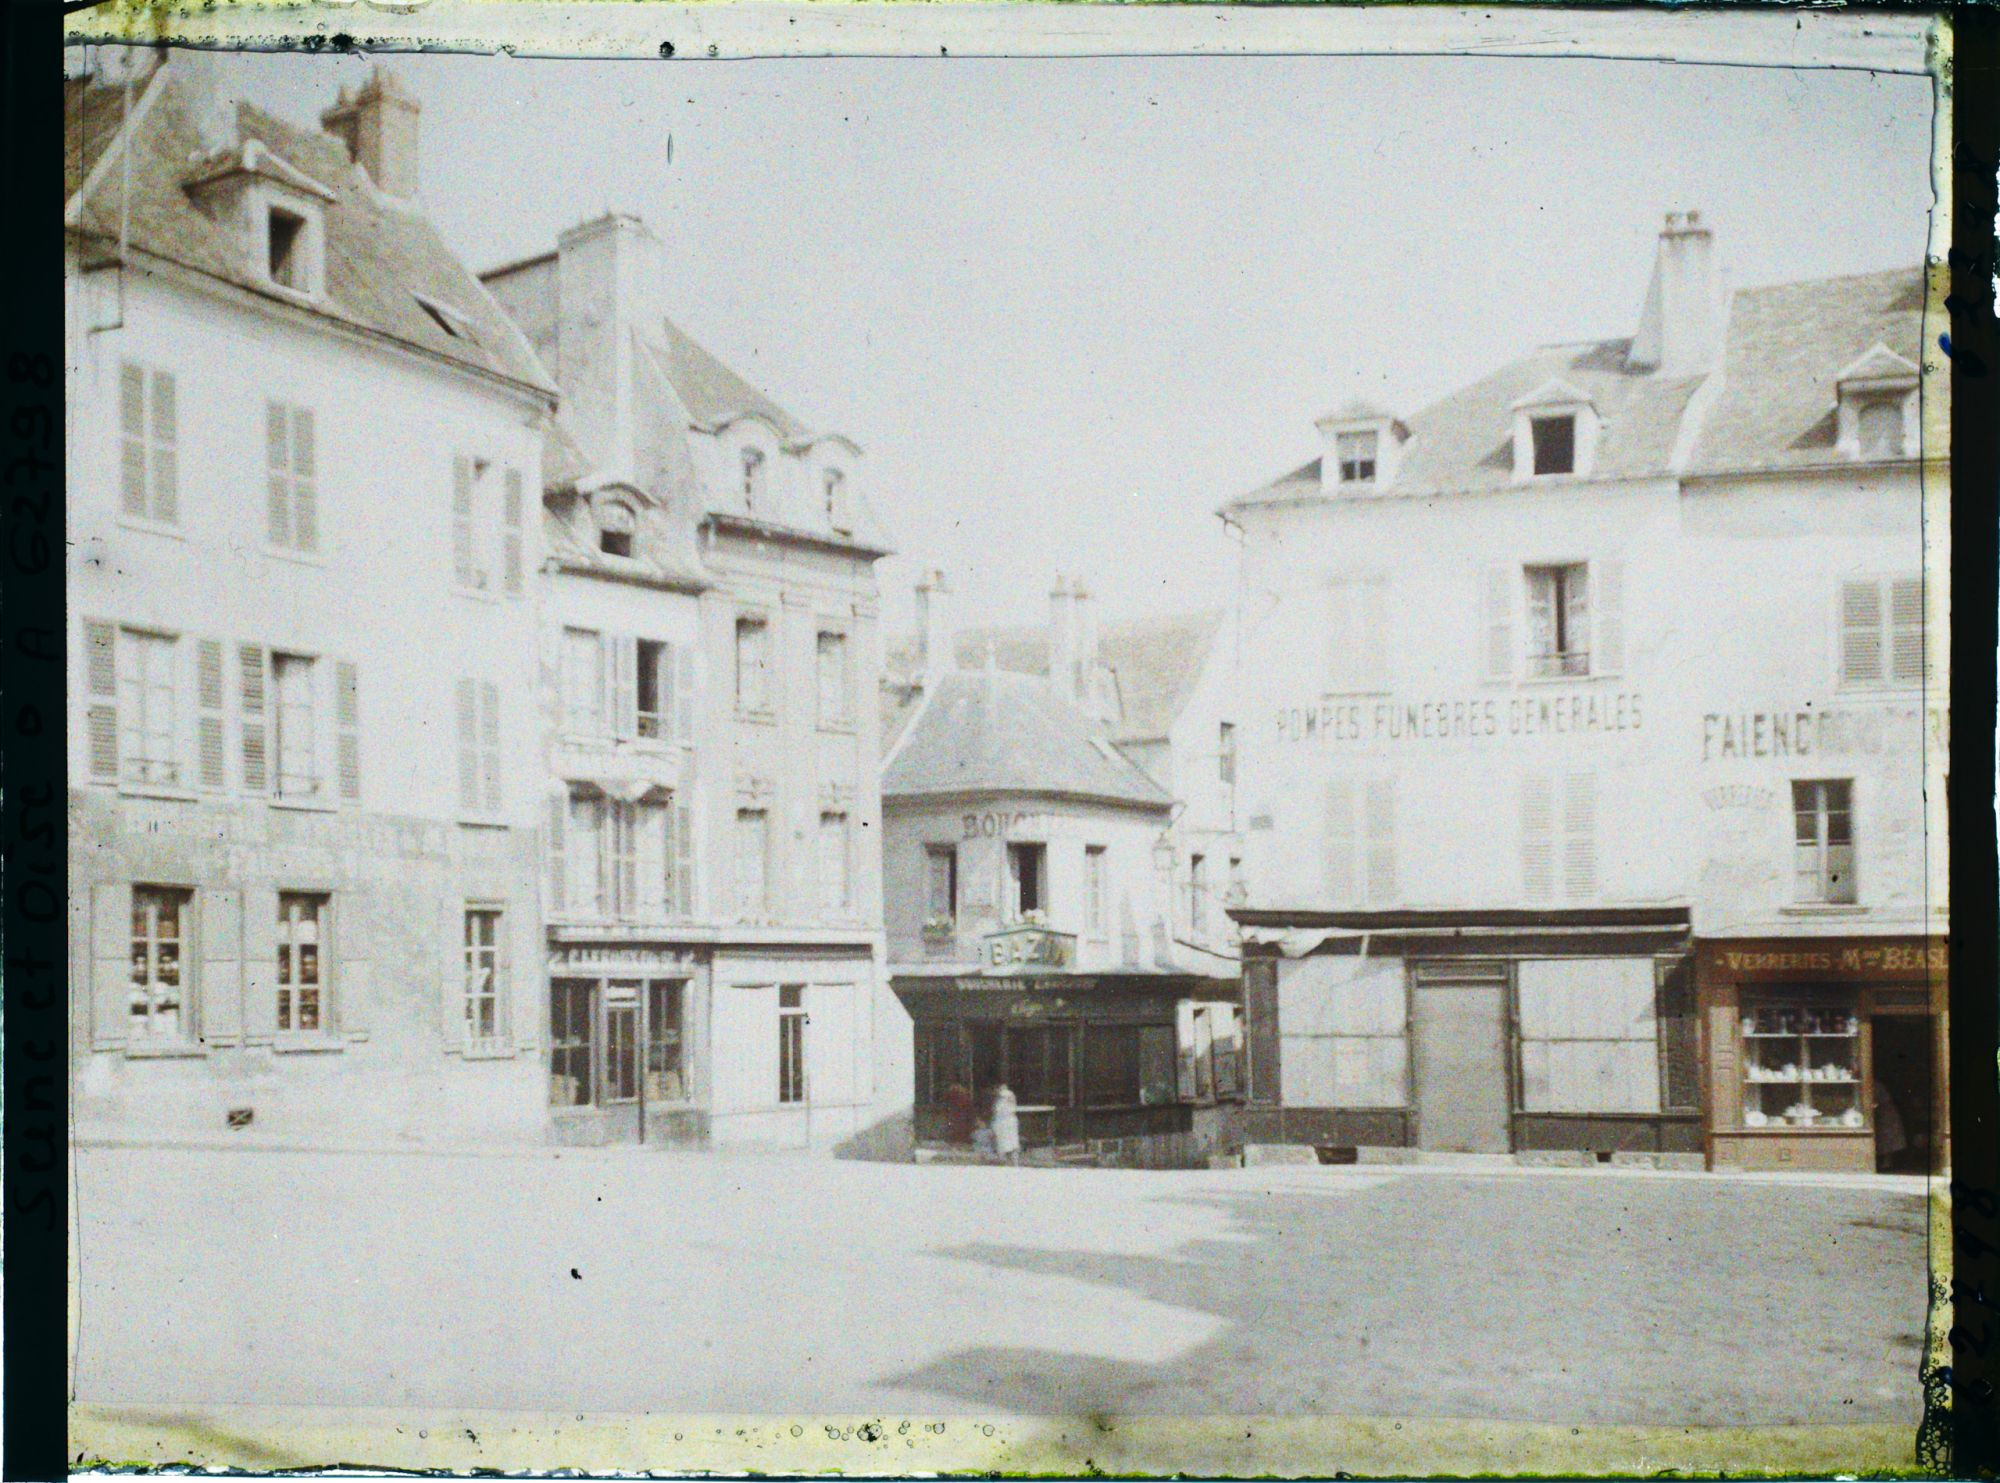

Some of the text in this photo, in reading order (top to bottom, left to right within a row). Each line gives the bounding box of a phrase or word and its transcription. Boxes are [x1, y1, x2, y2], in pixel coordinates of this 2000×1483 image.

[6, 350, 56, 575] 62798
[1276, 692, 1643, 742] POMPES FUNEBRES GENERALES
